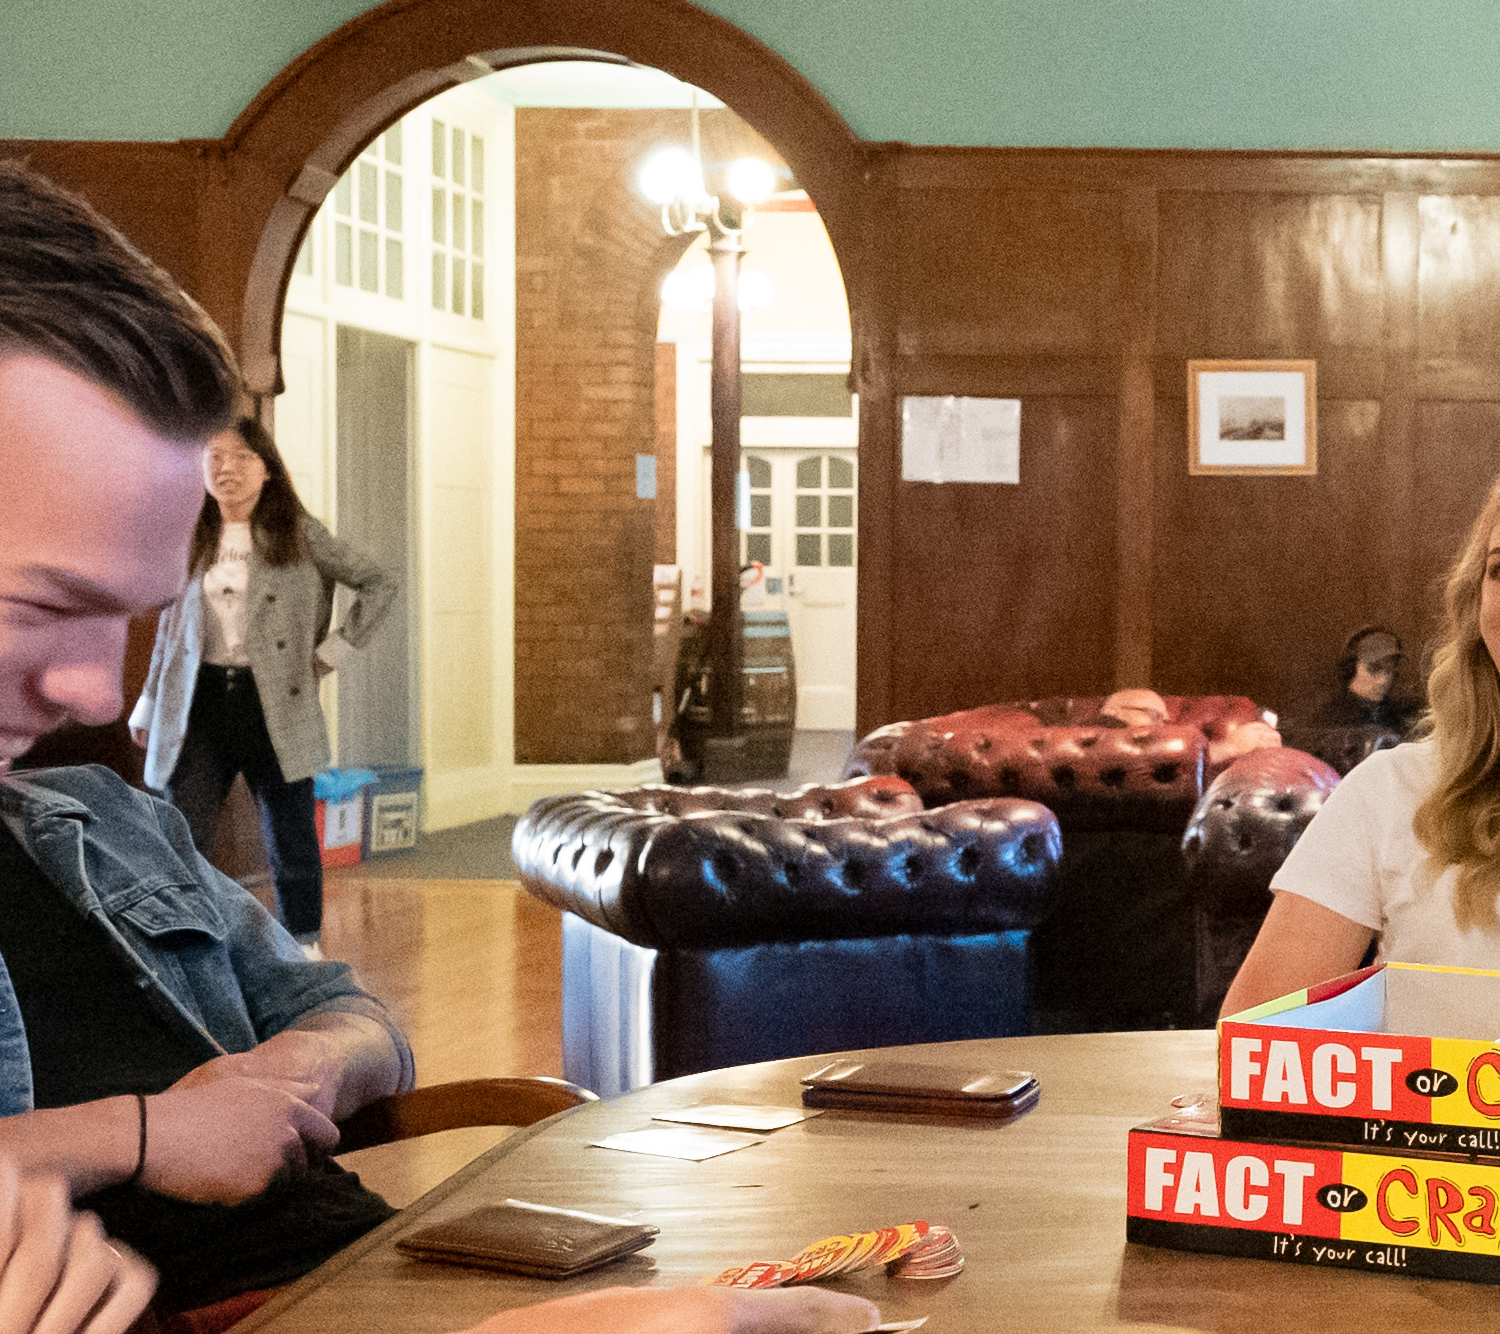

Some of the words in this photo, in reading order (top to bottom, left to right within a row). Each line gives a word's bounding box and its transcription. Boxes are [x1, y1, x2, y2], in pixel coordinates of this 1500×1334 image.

[1230, 1037, 1403, 1112] FACT
[1415, 1071, 1448, 1093] or
[1364, 1119, 1393, 1143] It's
[1404, 1129, 1448, 1146] your
[1457, 1130, 1500, 1150] call!
[1144, 1147, 1316, 1226] FACT
[1326, 1187, 1358, 1207] or
[1273, 1235, 1302, 1256] It's
[1312, 1247, 1356, 1262] your
[1365, 1247, 1407, 1267] call!
